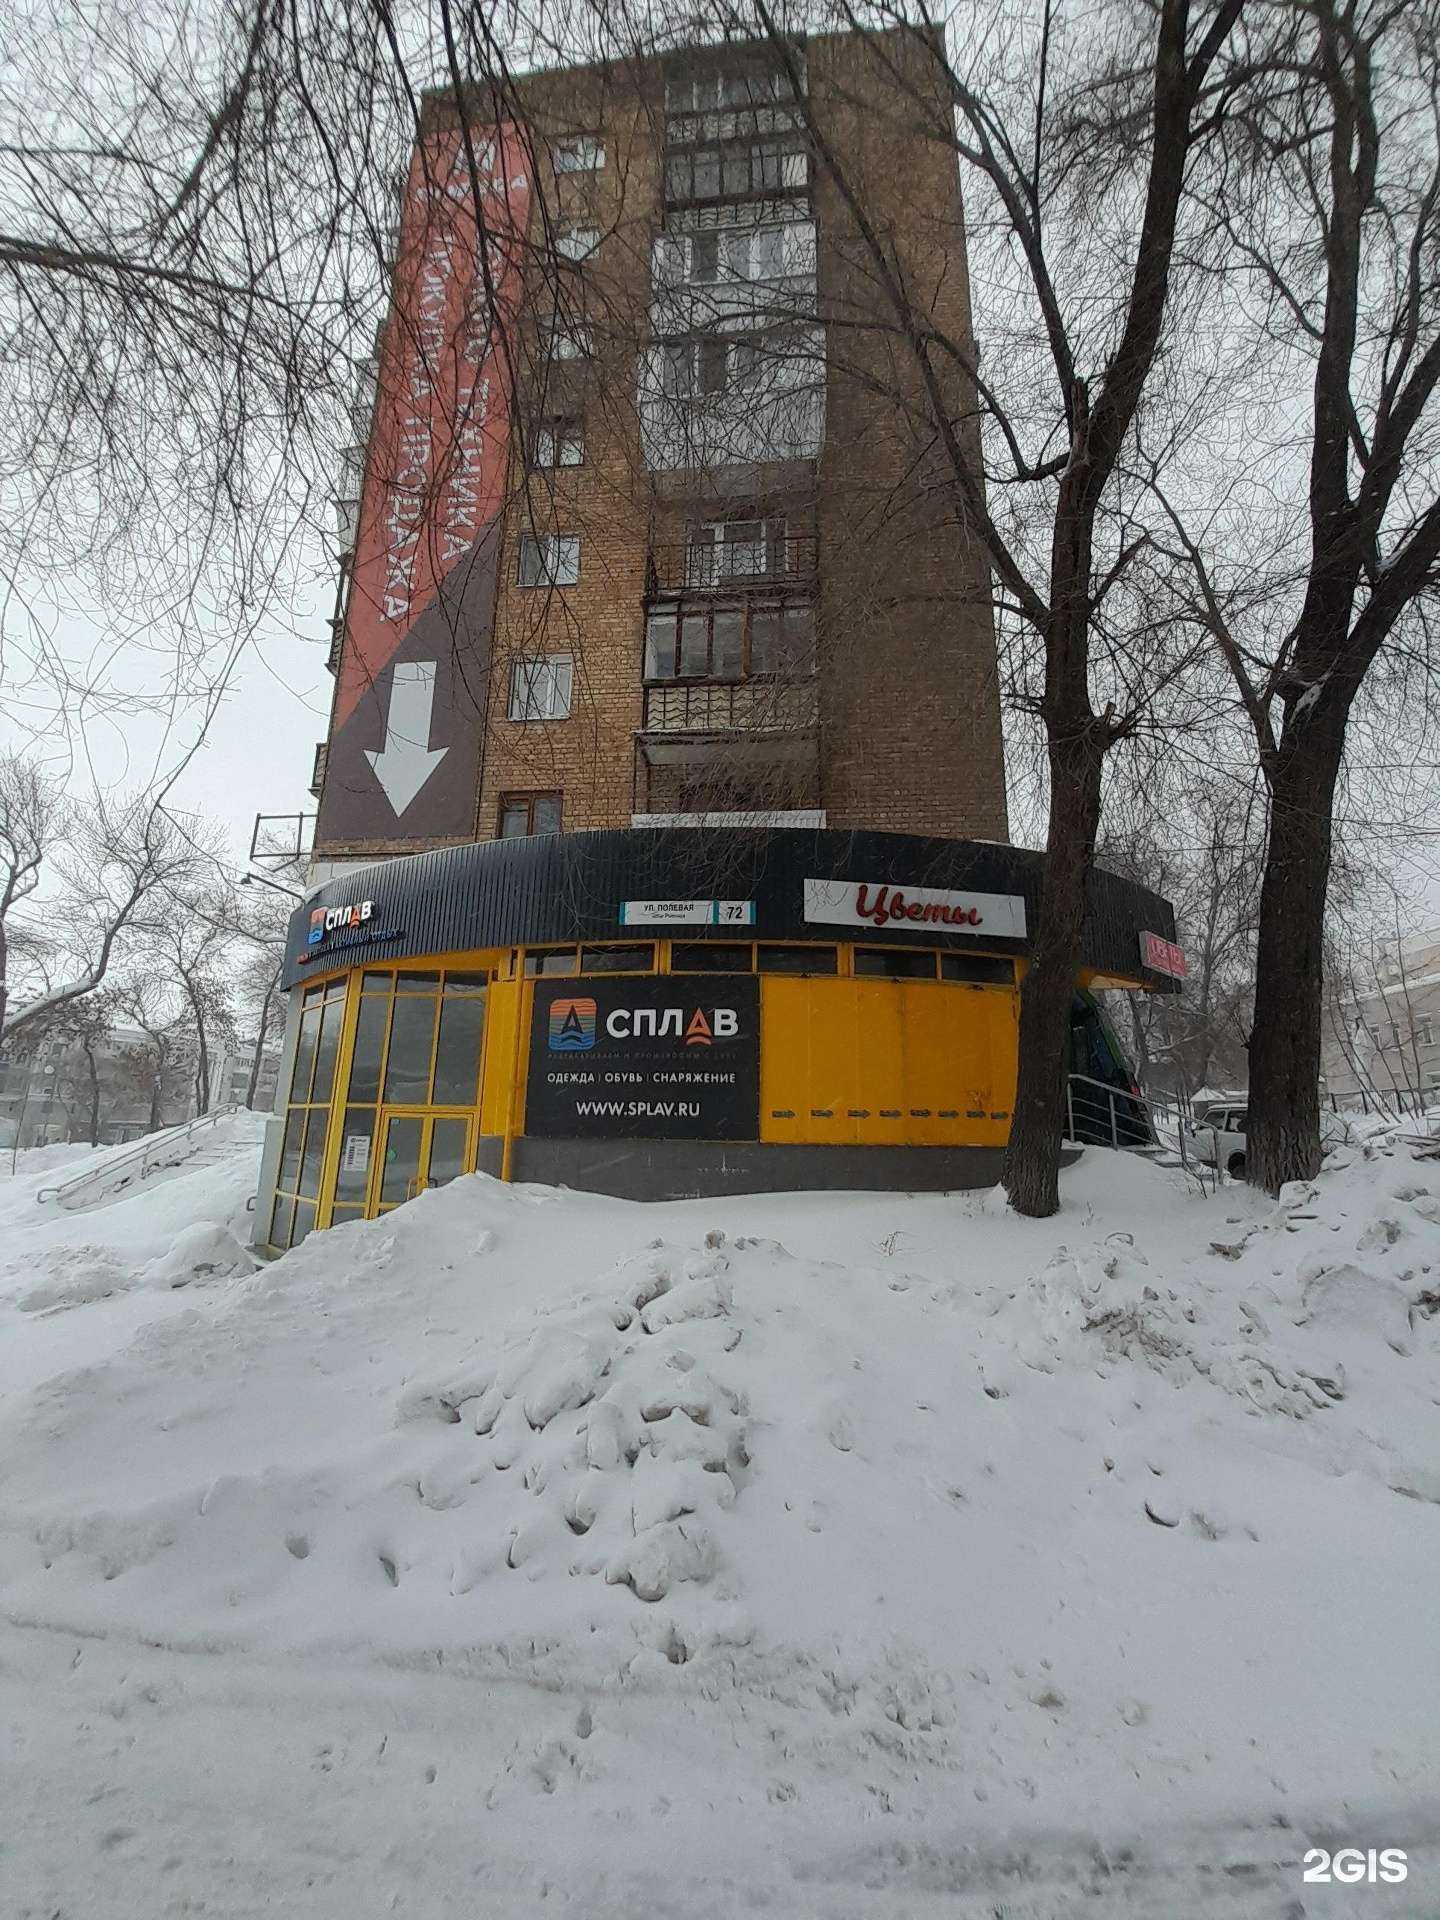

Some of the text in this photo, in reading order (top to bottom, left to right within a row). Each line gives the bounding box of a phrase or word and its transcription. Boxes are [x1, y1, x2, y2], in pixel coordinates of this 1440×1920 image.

[380, 416, 434, 622] ПРОДАЖА
[326, 900, 374, 931] СПЛАВ
[657, 903, 694, 912] ПОЛЕВАЯ
[727, 906, 743, 920] 72
[856, 884, 983, 925] Цветы
[606, 1007, 739, 1046] СПЛАВ
[547, 1072, 736, 1084] ОДЕЖДА ОБУВЬ СНАРЯЖЕНИЕ
[576, 1101, 700, 1116] WWW.SPLAV.RU
